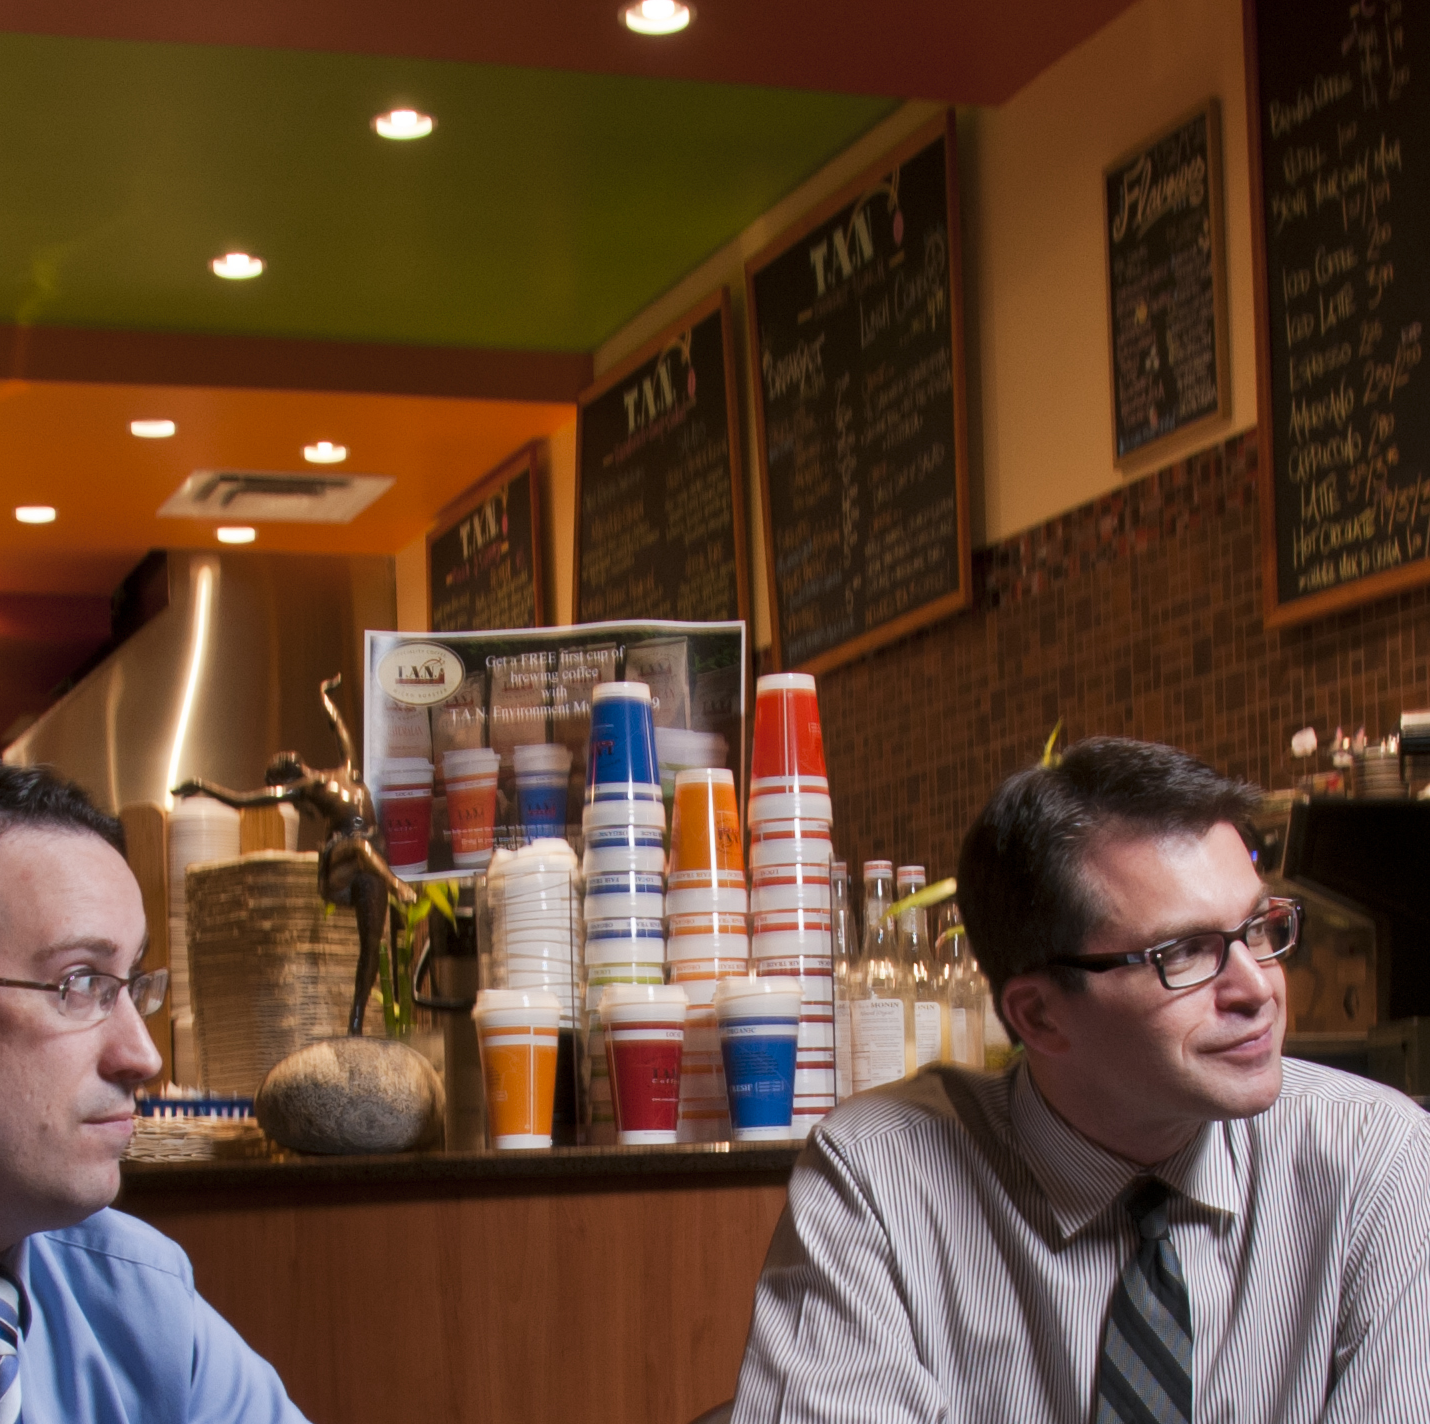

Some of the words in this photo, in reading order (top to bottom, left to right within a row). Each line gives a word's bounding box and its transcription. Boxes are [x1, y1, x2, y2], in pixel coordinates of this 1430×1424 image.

[485, 655, 506, 669] Get
[520, 652, 557, 666] FREE
[560, 650, 584, 664] first
[586, 650, 608, 665] cup
[611, 646, 625, 661] of
[510, 669, 558, 685] brewing
[562, 666, 599, 680] coffee
[541, 686, 568, 699] with
[492, 703, 571, 719] Environment
